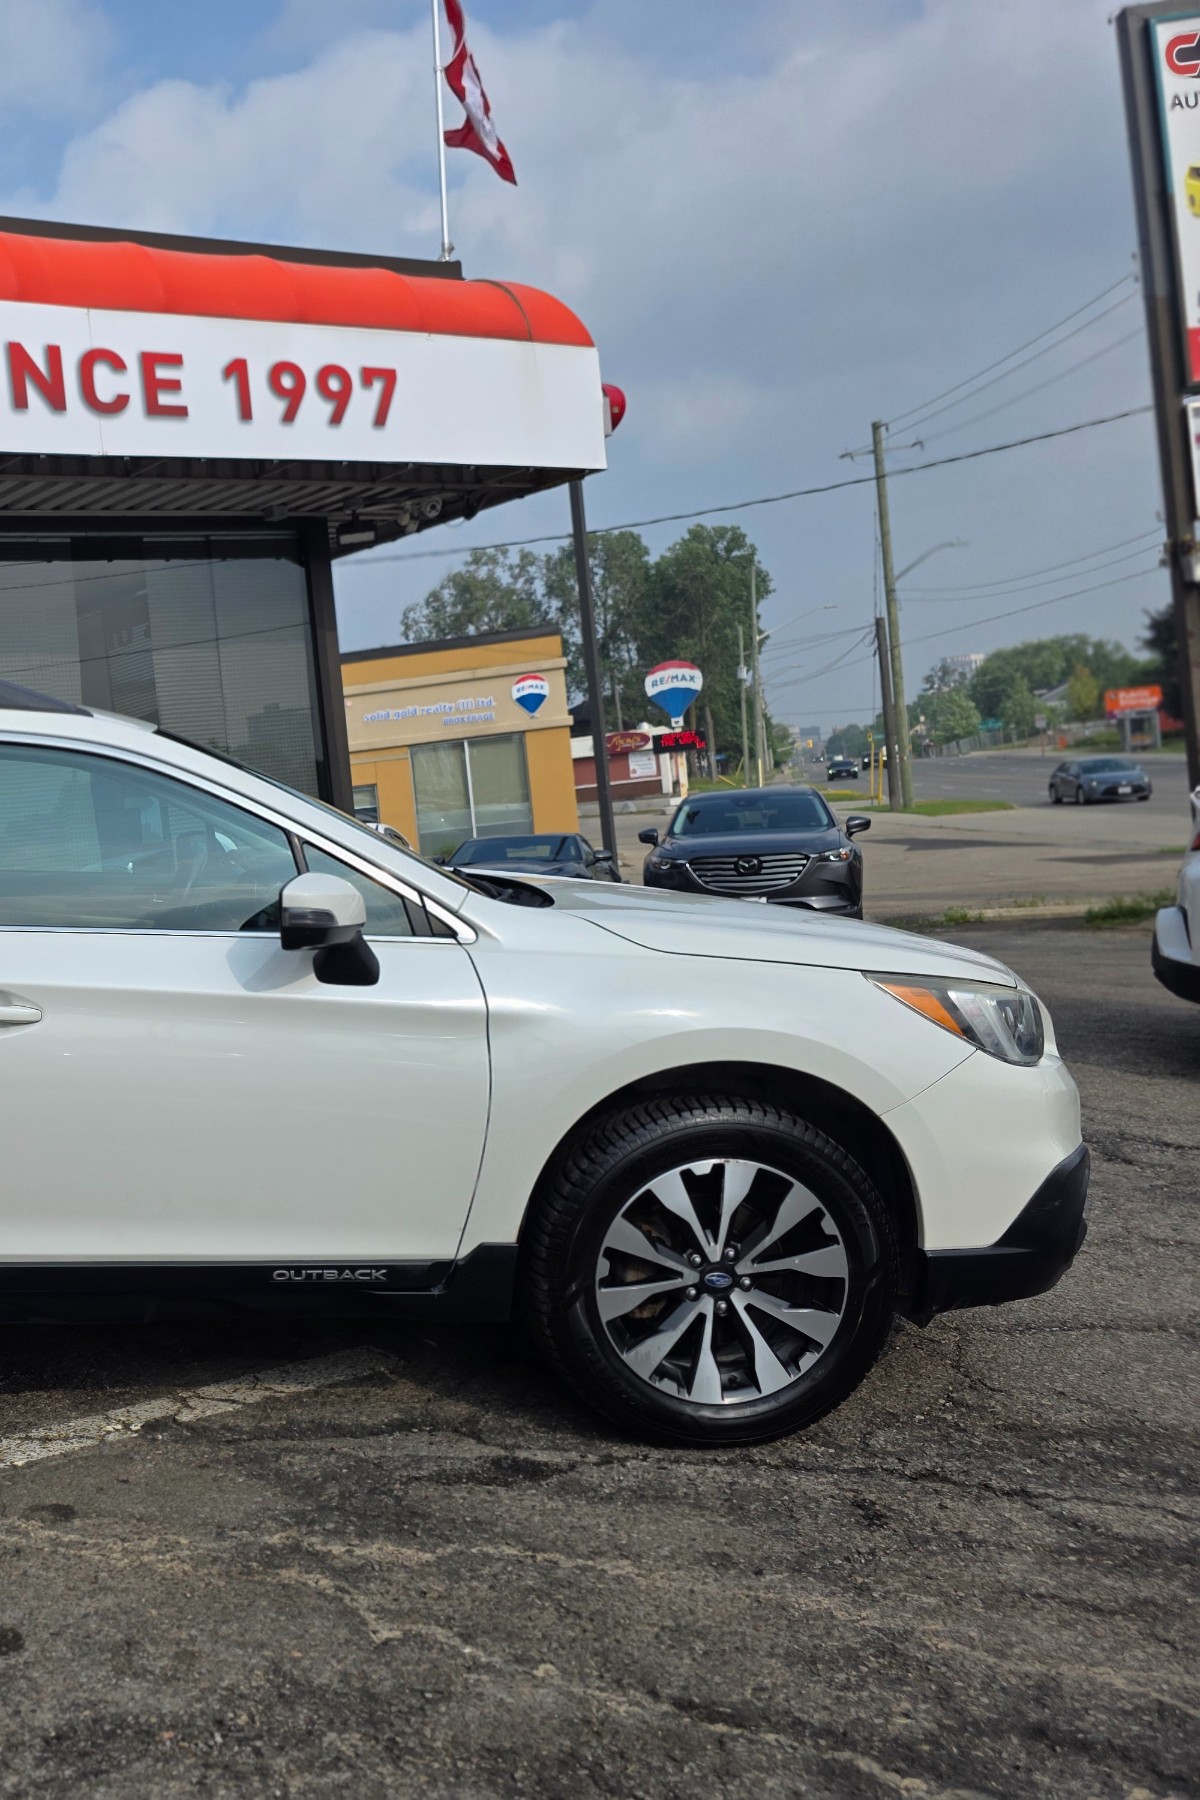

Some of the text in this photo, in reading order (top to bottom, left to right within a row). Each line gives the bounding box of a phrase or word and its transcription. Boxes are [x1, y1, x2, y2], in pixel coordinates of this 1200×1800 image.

[1171, 90, 1200, 112] AU
[222, 357, 397, 428] 1997
[515, 684, 544, 693] RE/MAX
[652, 674, 696, 689] RE/MAX
[363, 711, 390, 722] solid
[394, 708, 418, 721] gold
[421, 702, 454, 716] realty
[443, 713, 494, 726] BROKERAGE
[272, 1269, 388, 1281] OUTBACK
